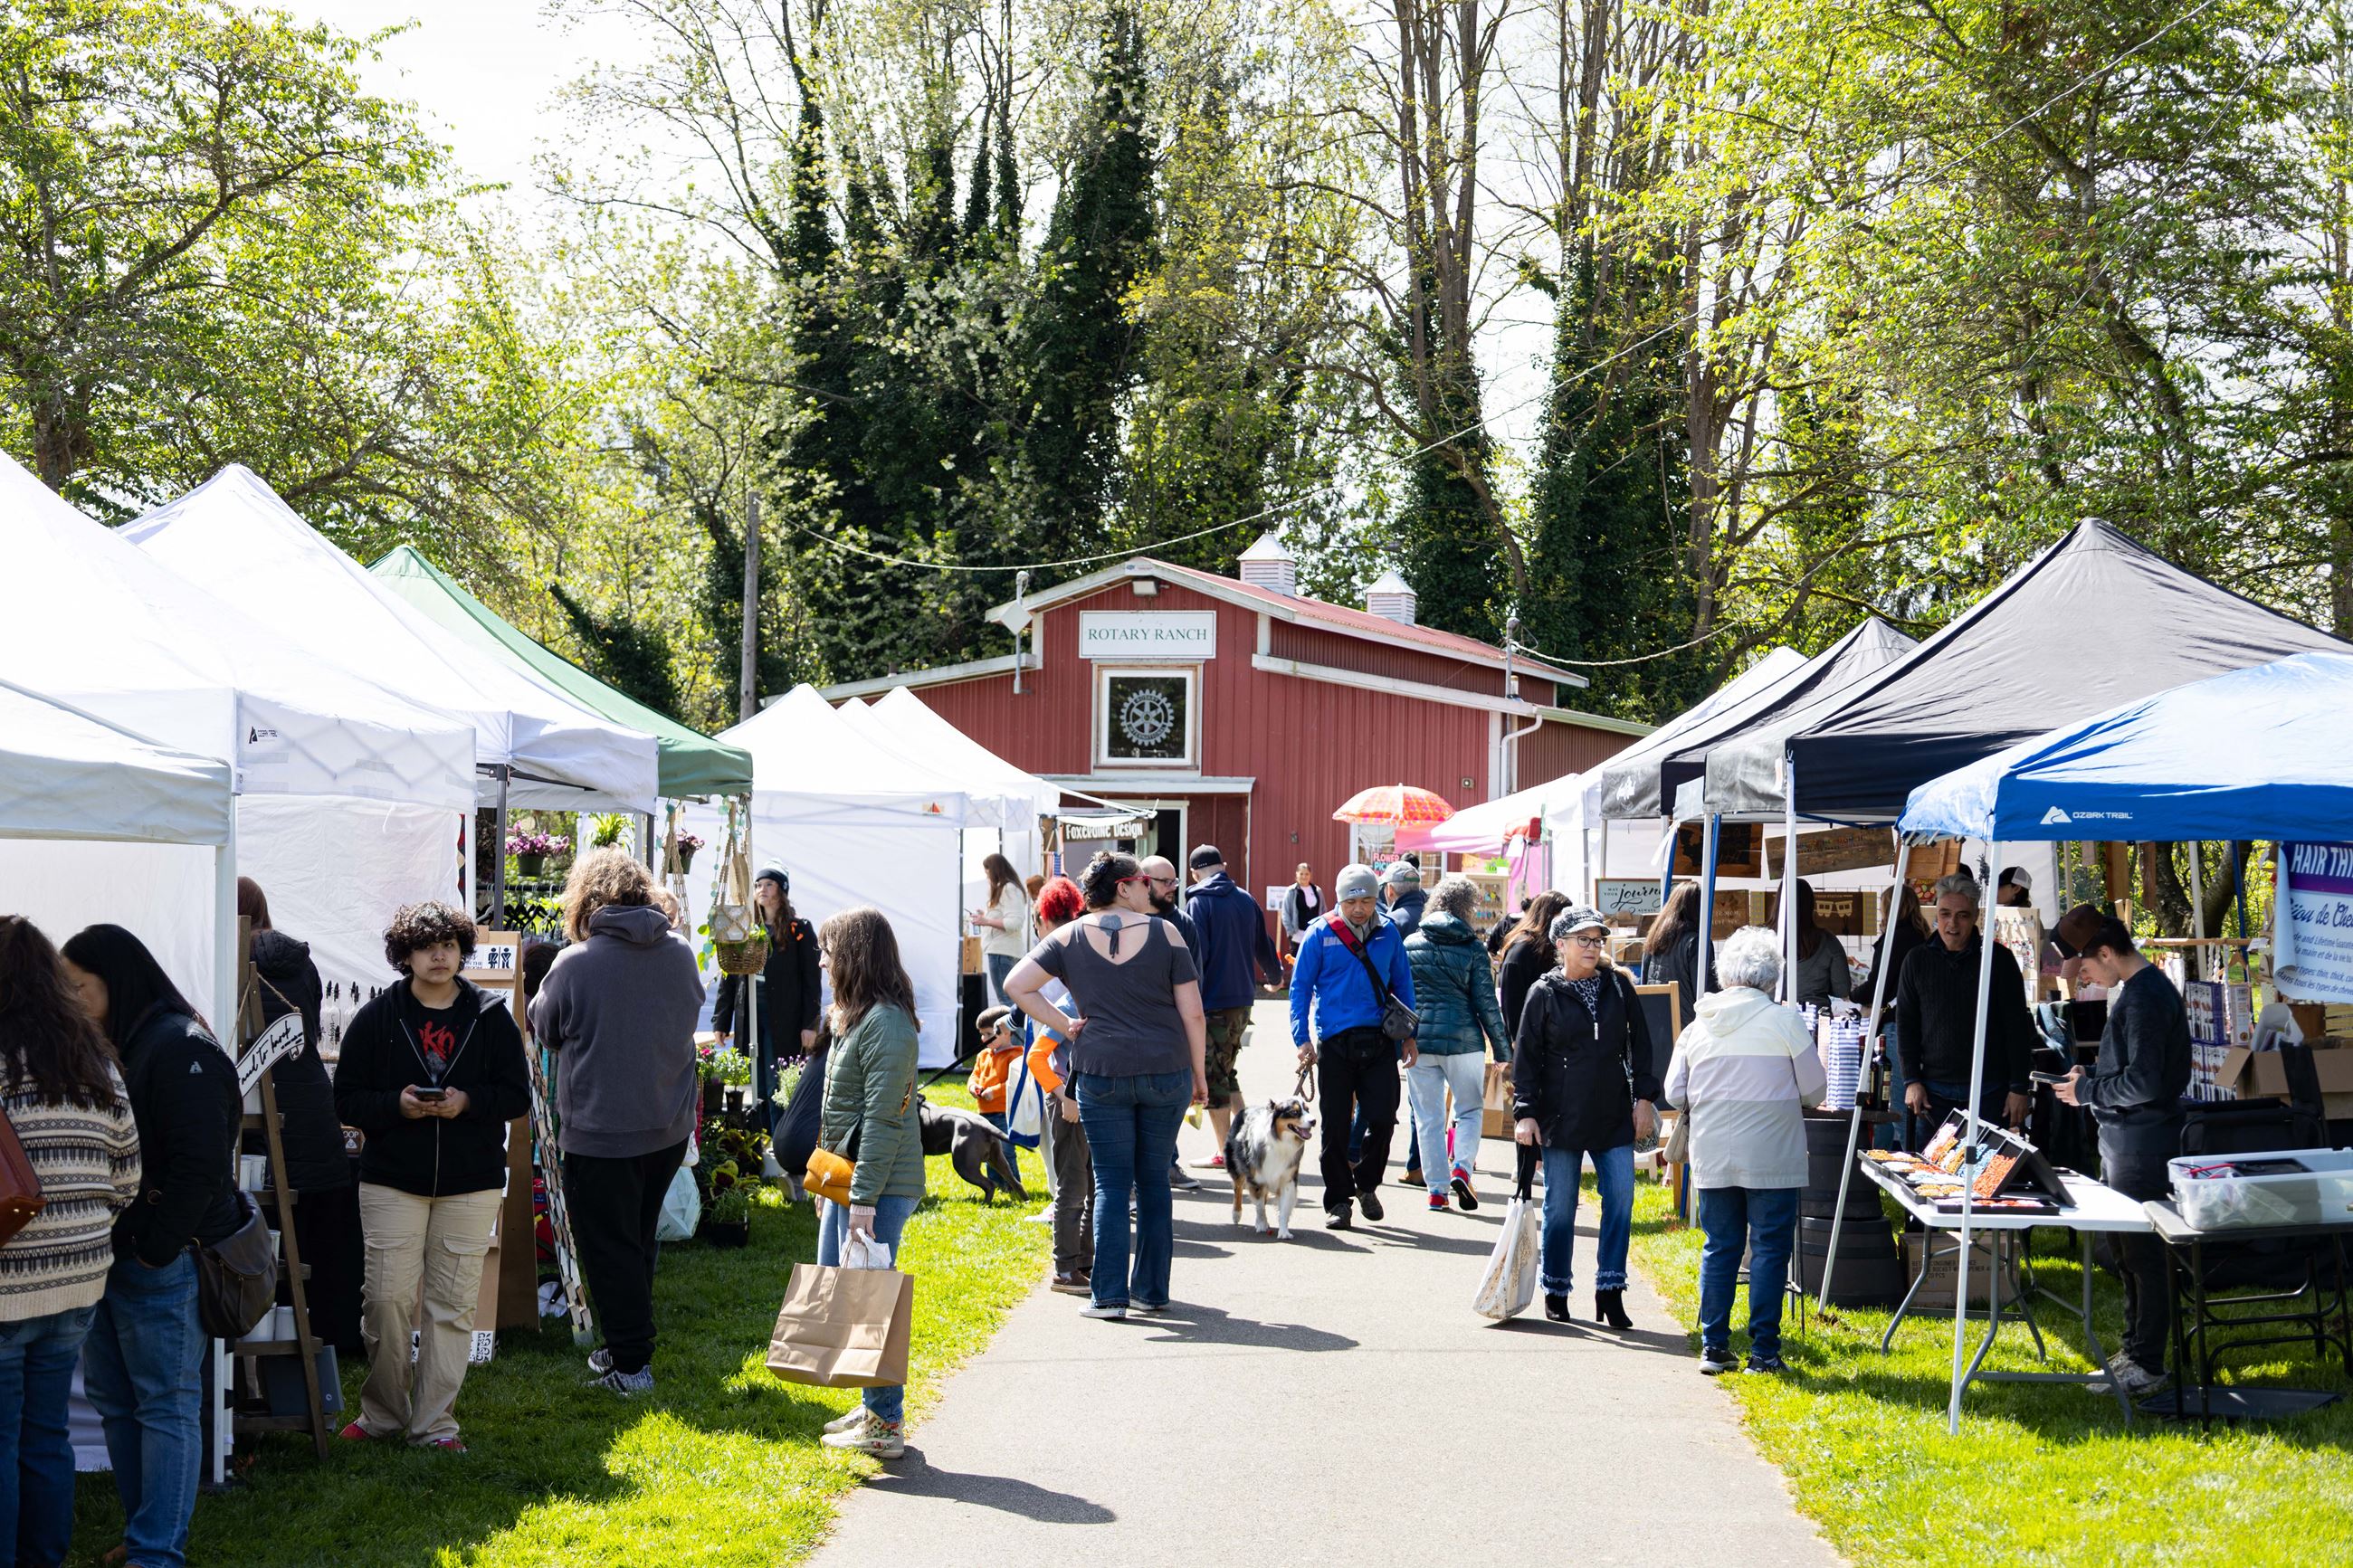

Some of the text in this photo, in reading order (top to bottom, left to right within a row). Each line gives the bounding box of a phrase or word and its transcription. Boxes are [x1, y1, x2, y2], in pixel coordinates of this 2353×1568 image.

[1088, 628, 1207, 641] ROTARY RANCH
[1113, 822, 1143, 839] Design
[2291, 844, 2353, 879] HAIR THI
[2316, 903, 2329, 926] de
[2333, 901, 2353, 928] Che
